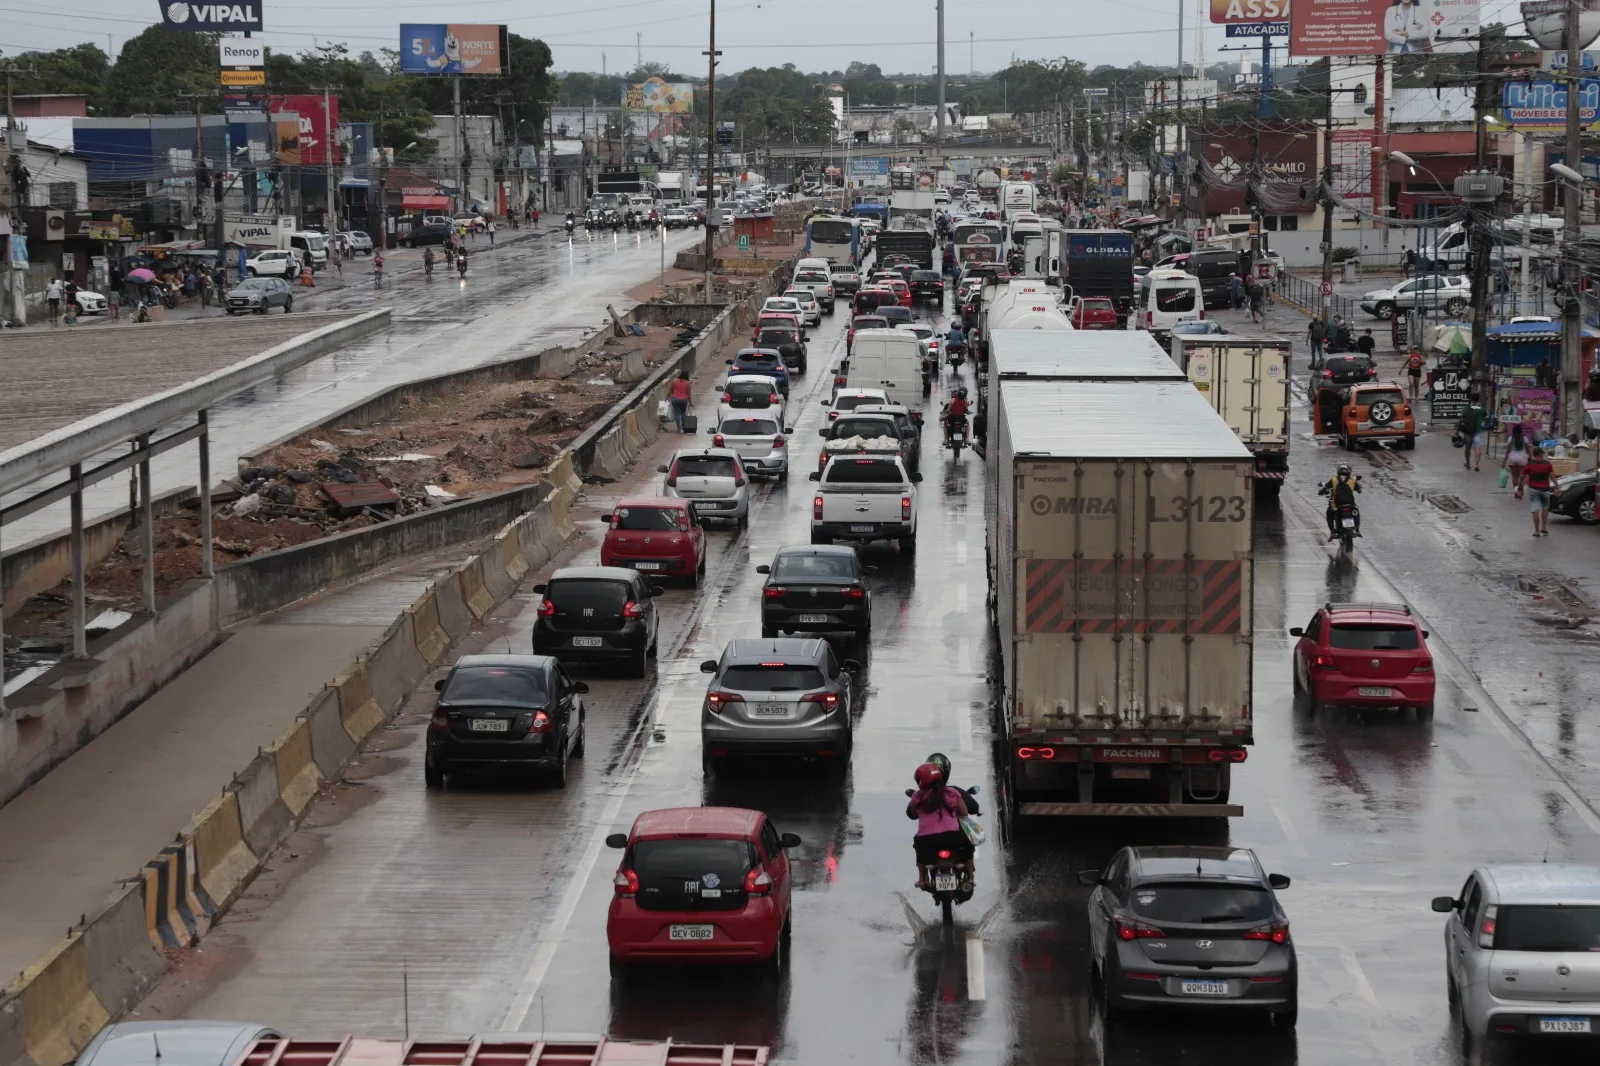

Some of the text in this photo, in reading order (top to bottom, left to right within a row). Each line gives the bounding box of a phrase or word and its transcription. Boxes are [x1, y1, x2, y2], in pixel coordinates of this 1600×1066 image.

[192, 5, 258, 22] VIPAL
[463, 41, 495, 49] NORTE
[225, 47, 259, 59] Renop
[222, 74, 257, 82] Continental
[1512, 108, 1549, 117] MÓVEIS
[239, 228, 272, 238] VIPAL
[1054, 498, 1117, 514] MIRA
[1149, 495, 1246, 522] L3123
[1143, 576, 1199, 592] LONGO
[1103, 749, 1160, 758] FACCHINI
[685, 881, 700, 894] FIAT
